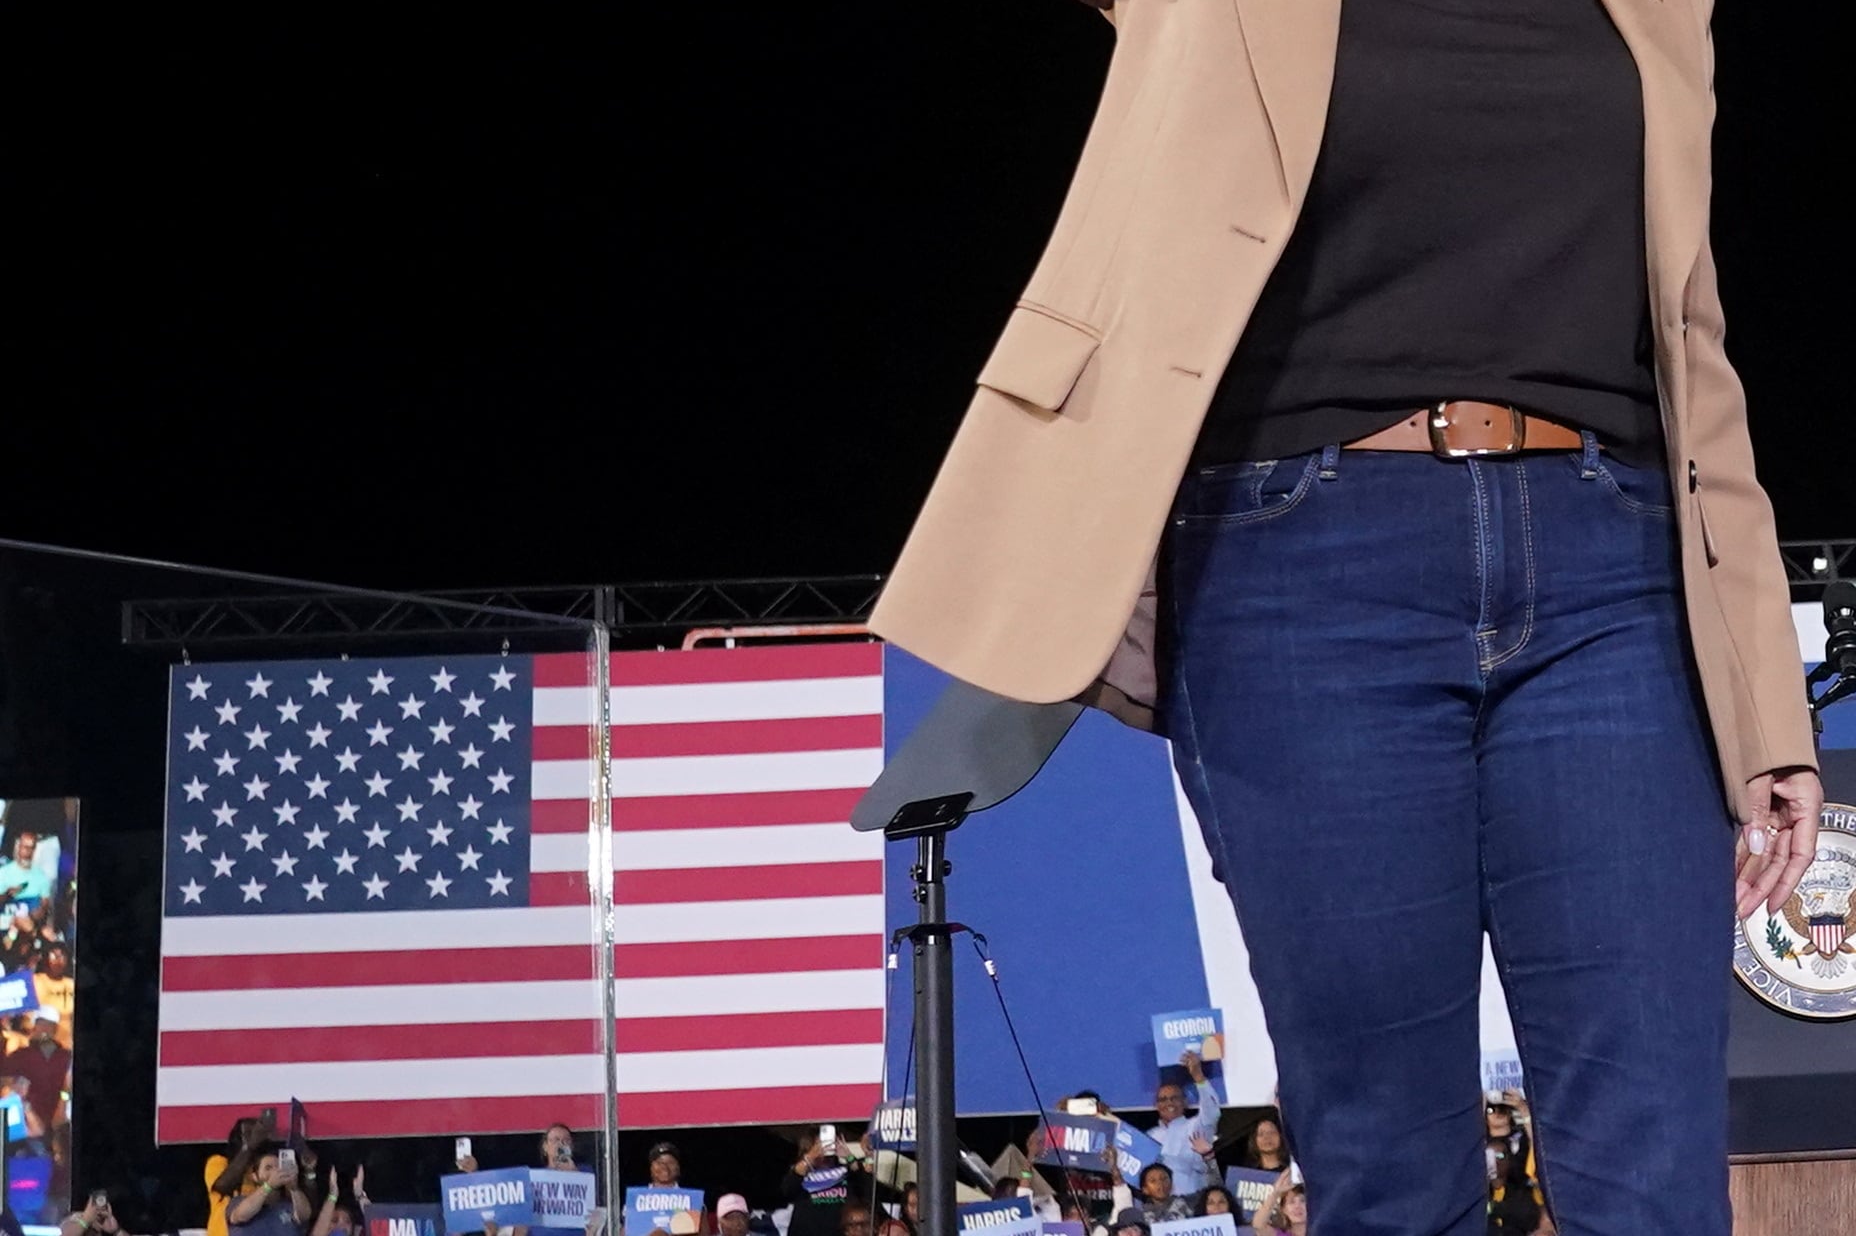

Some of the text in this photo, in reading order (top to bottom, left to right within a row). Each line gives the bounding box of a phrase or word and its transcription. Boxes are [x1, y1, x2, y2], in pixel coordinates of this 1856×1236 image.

[1821, 812, 1856, 831] THE
[1742, 959, 1792, 1006] VICE
[1163, 1016, 1216, 1039] GEORGIA
[1489, 1075, 1522, 1091] FORW
[875, 1107, 917, 1131] HARRI
[1044, 1126, 1106, 1153] KAMALA
[448, 1180, 525, 1212] FREEDOM
[563, 1183, 588, 1201] WAY
[1237, 1180, 1273, 1201] HARR
[533, 1199, 584, 1216] RWARD
[636, 1193, 690, 1212] GEORGIA
[962, 1207, 1021, 1231] HARRIS
